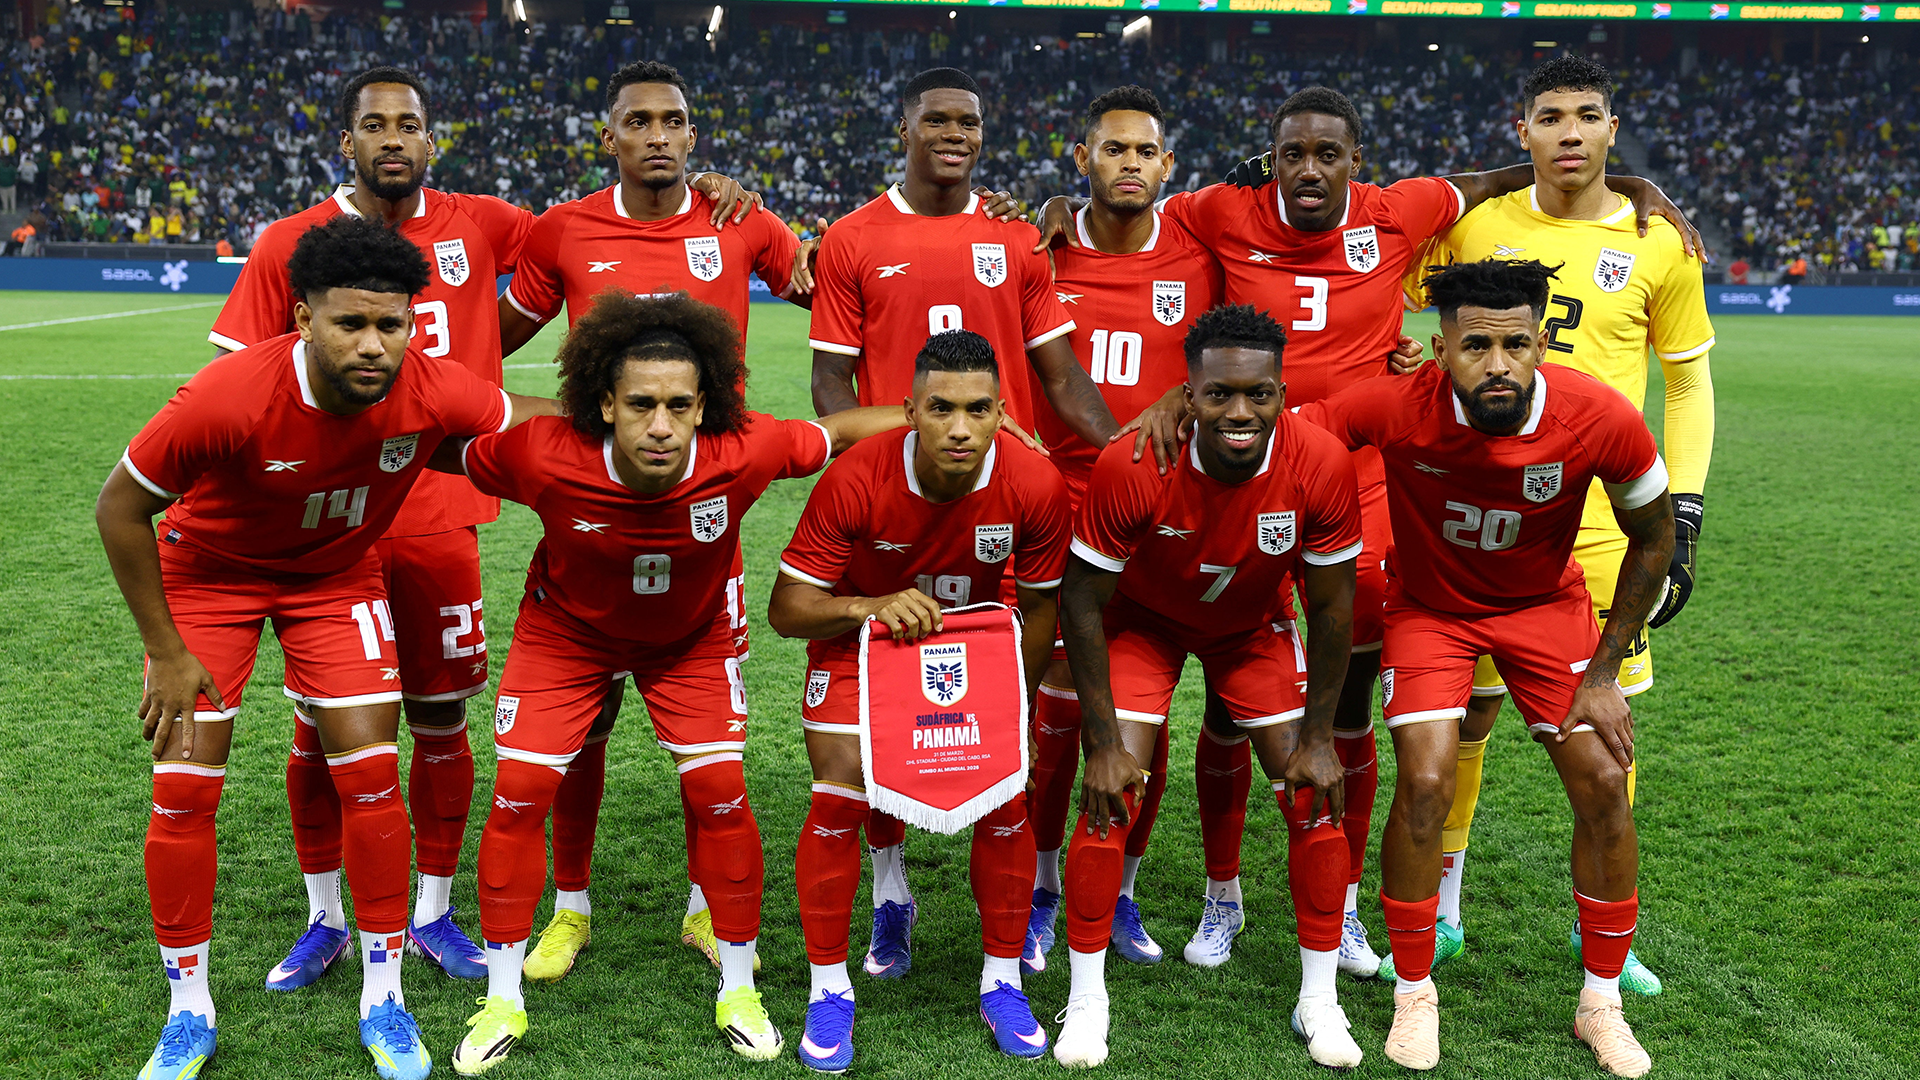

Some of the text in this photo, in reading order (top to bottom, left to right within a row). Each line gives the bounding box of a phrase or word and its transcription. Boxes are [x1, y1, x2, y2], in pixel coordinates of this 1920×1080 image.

[1291, 276, 1328, 331] 3
[409, 300, 451, 358] 3
[1090, 329, 1143, 386] 10
[301, 485, 370, 529] 14
[1443, 500, 1522, 551] 20
[633, 553, 671, 595] 8
[914, 575, 972, 611] 19
[1199, 563, 1237, 603] 7
[924, 646, 962, 656] PANAMÁ
[724, 657, 748, 715] 8
[912, 720, 981, 750] PANAMÁ
[916, 711, 964, 727] SUDÁFRICA
[916, 757, 938, 765] STADIUM
[940, 755, 958, 763] CIUDAD
